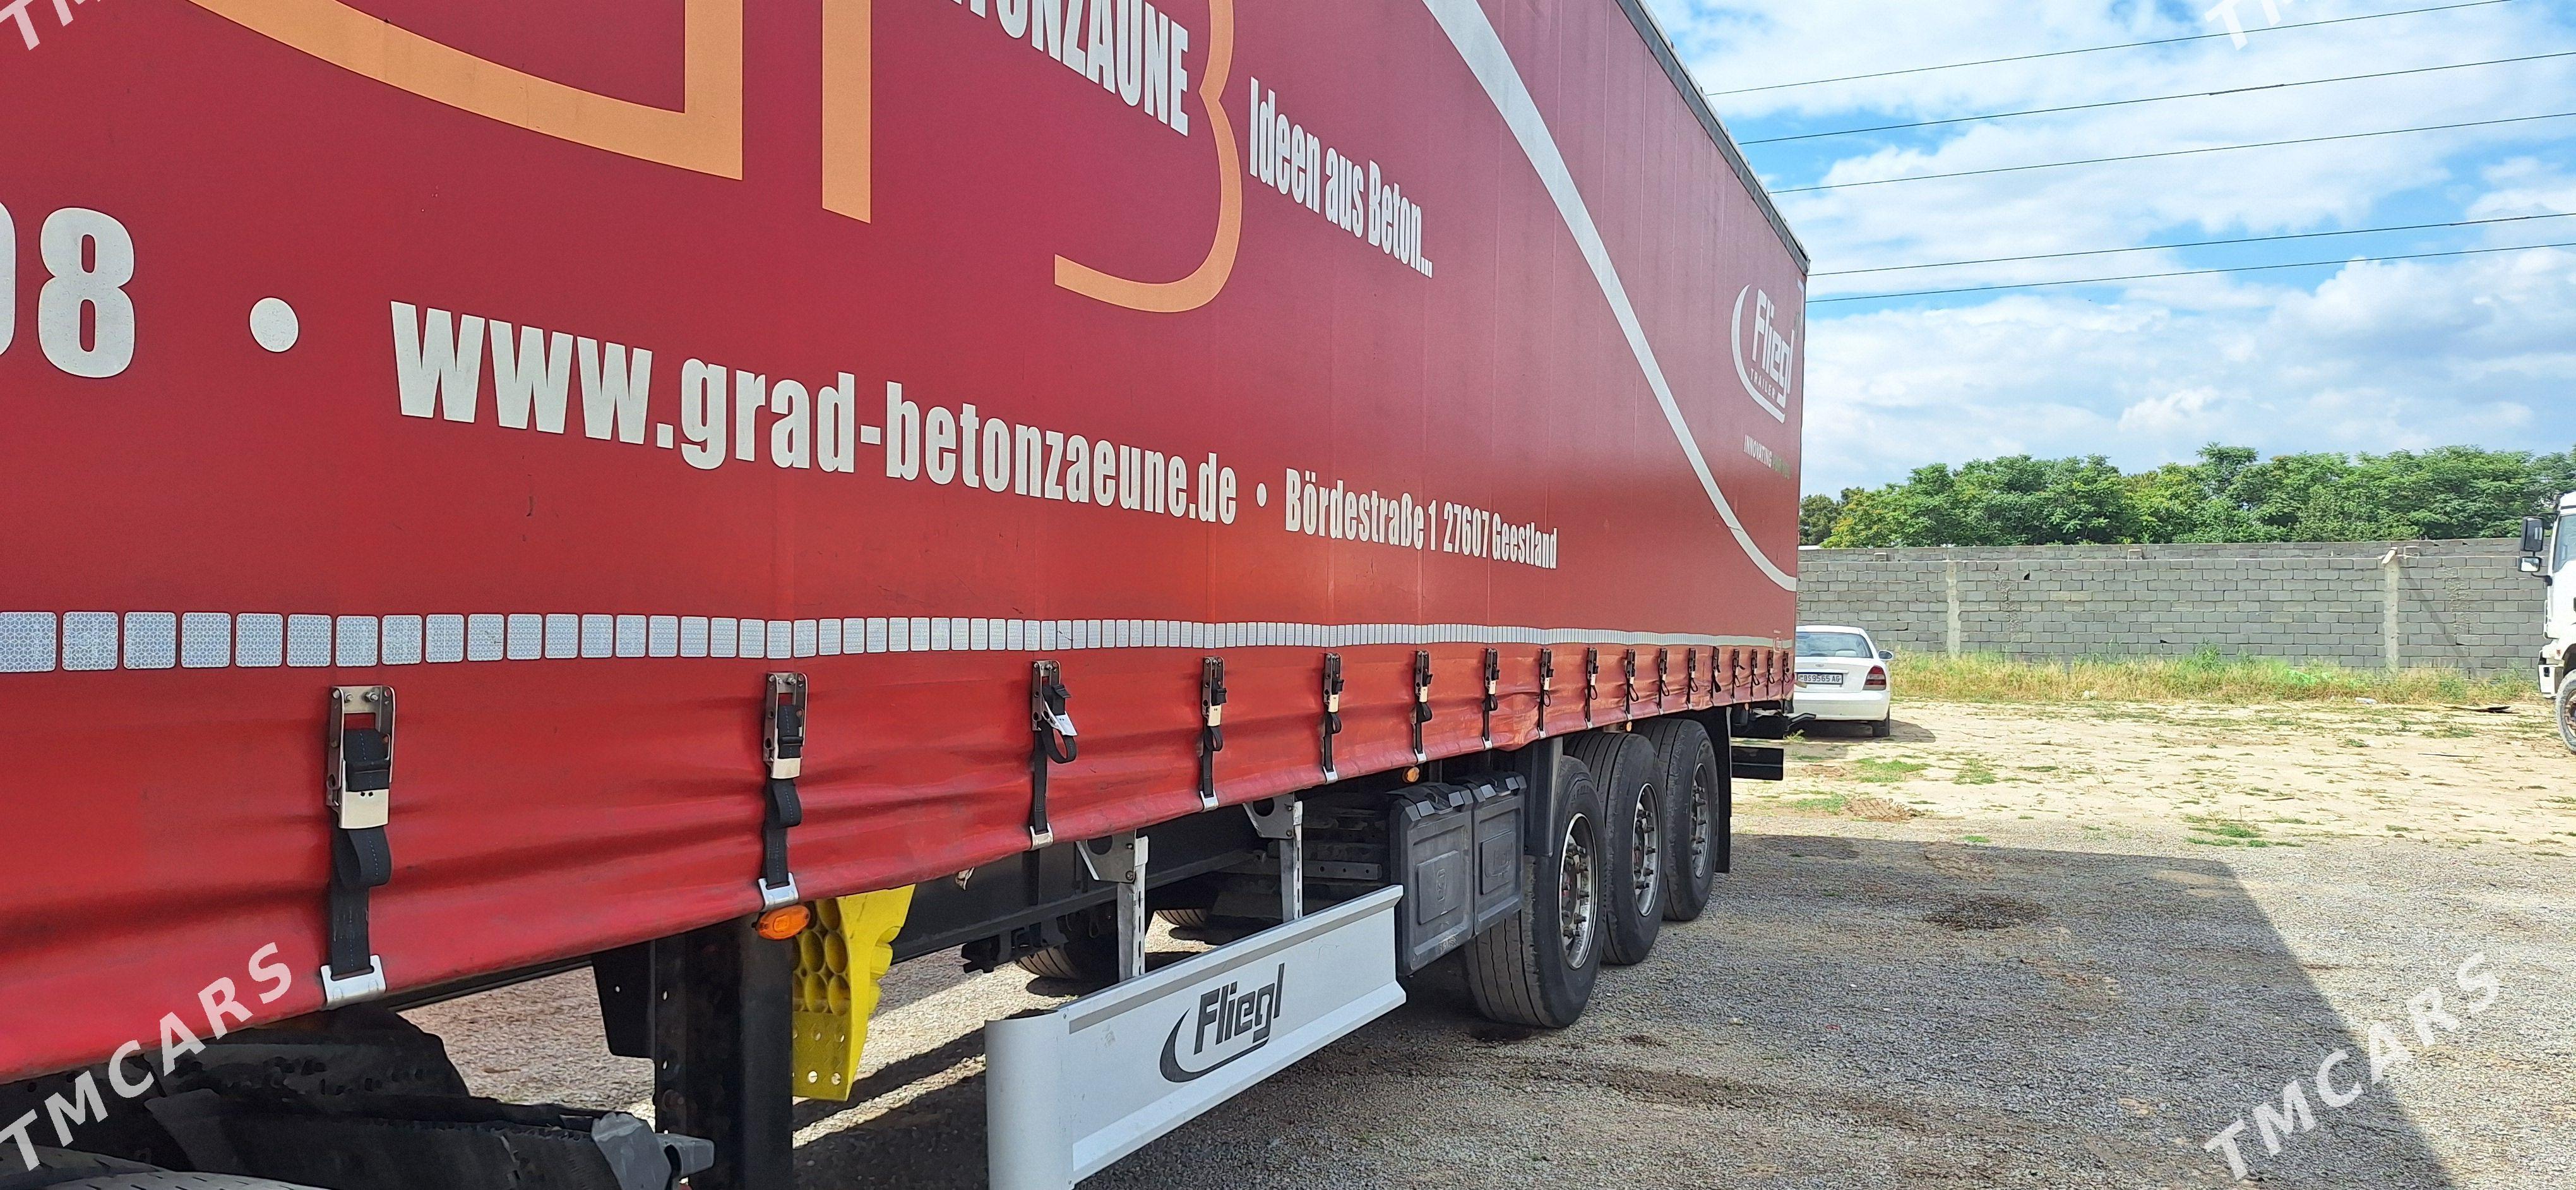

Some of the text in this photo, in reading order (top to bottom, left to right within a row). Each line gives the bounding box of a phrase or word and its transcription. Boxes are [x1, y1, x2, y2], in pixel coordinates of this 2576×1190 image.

[1249, 76, 1433, 279] Ideen aus Beton...
[0, 201, 1558, 569] 8 www.grad-betonzaeune.de Bördestraße 1 27607 Geestland
[1750, 368, 1775, 400] TRAILER
[1752, 288, 1795, 409] Fliegl
[1743, 433, 1772, 469] INNOVATING
[1193, 962, 1285, 1055] Fliegl
